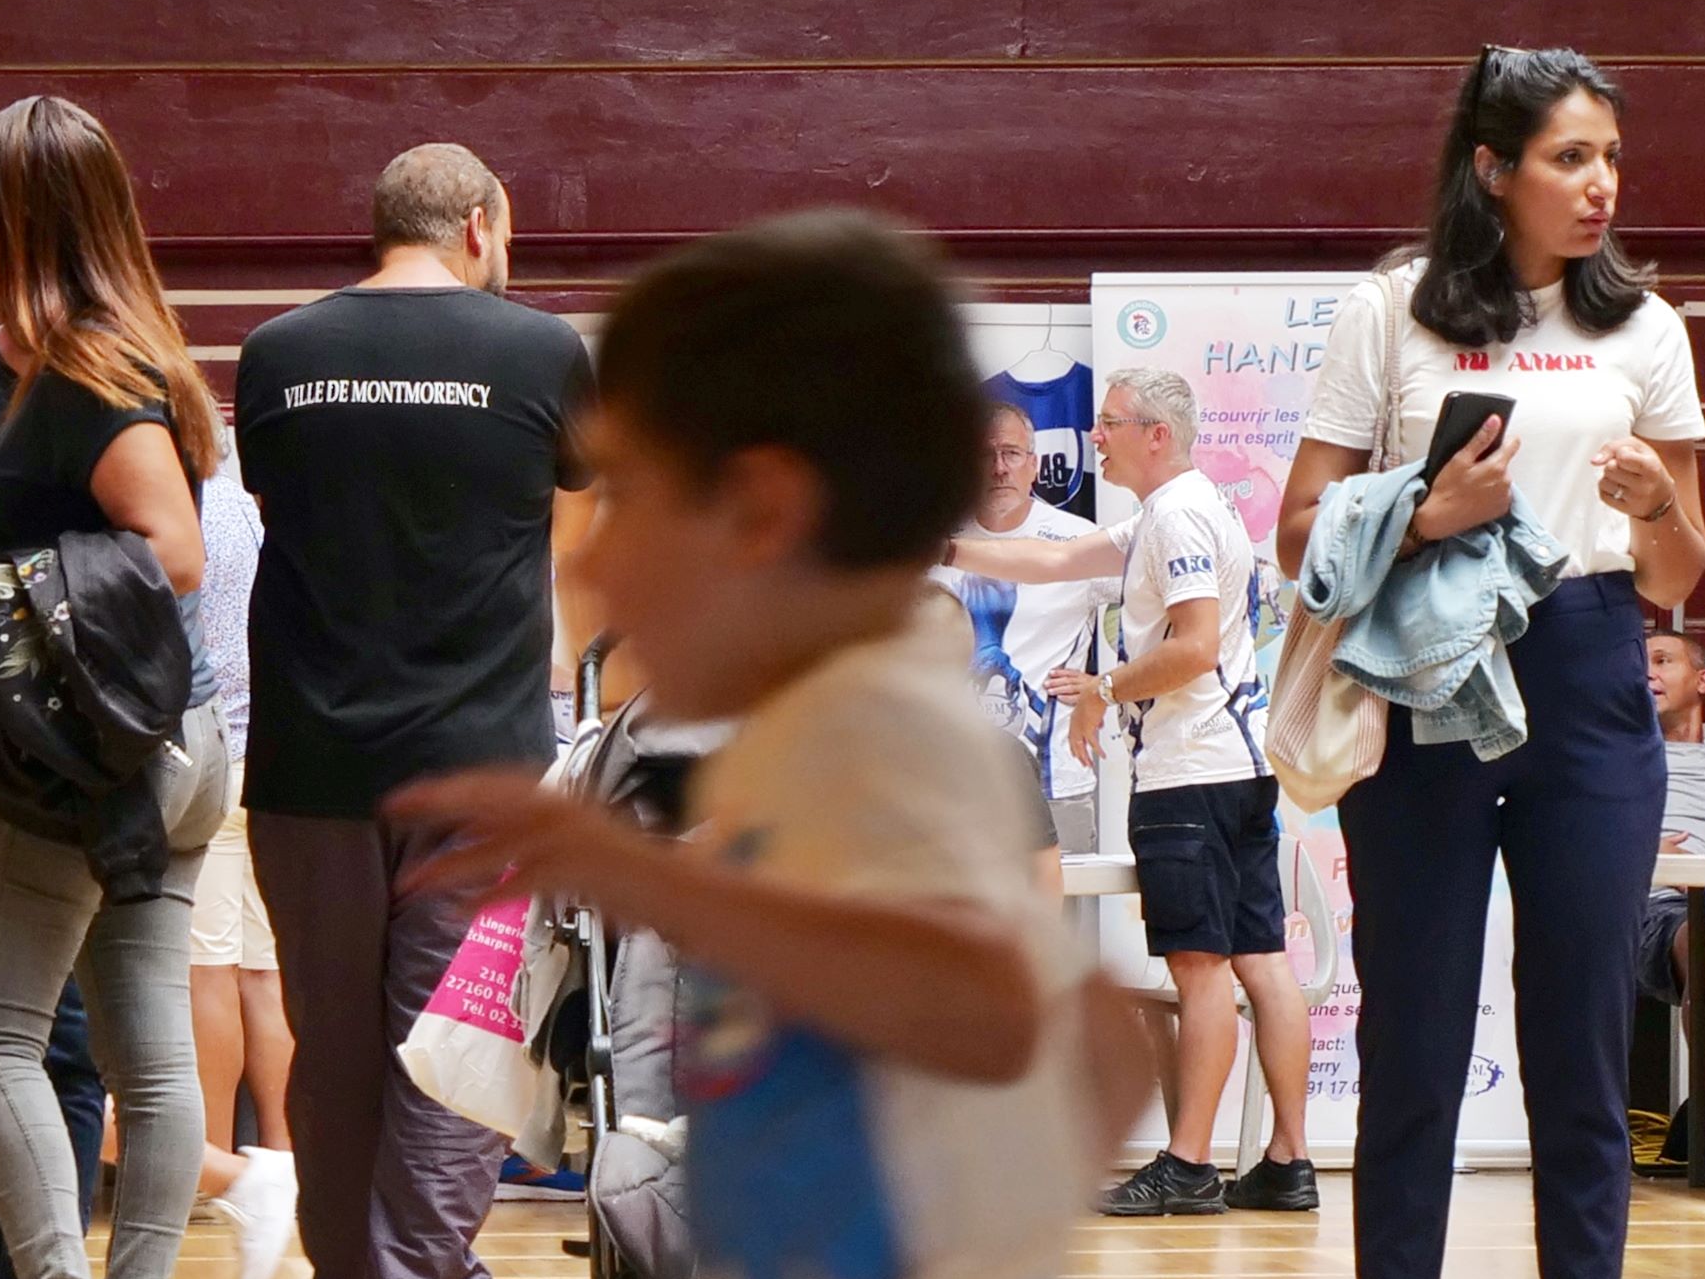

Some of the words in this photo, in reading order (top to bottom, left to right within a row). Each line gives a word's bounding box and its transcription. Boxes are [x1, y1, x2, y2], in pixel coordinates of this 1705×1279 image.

[1507, 352, 1597, 371] AMOR
[283, 380, 325, 409] VILLE
[326, 379, 349, 403] DE
[351, 380, 491, 408] MONTMORENCY
[1274, 408, 1300, 422] les
[1218, 433, 1239, 444] un
[1245, 430, 1295, 447] esprit
[1038, 452, 1067, 489] 48
[445, 975, 494, 1000] 27160
[479, 966, 508, 988] 218,
[460, 998, 485, 1017] Tél.
[489, 1010, 508, 1027] 02
[1330, 1080, 1348, 1095] 17
